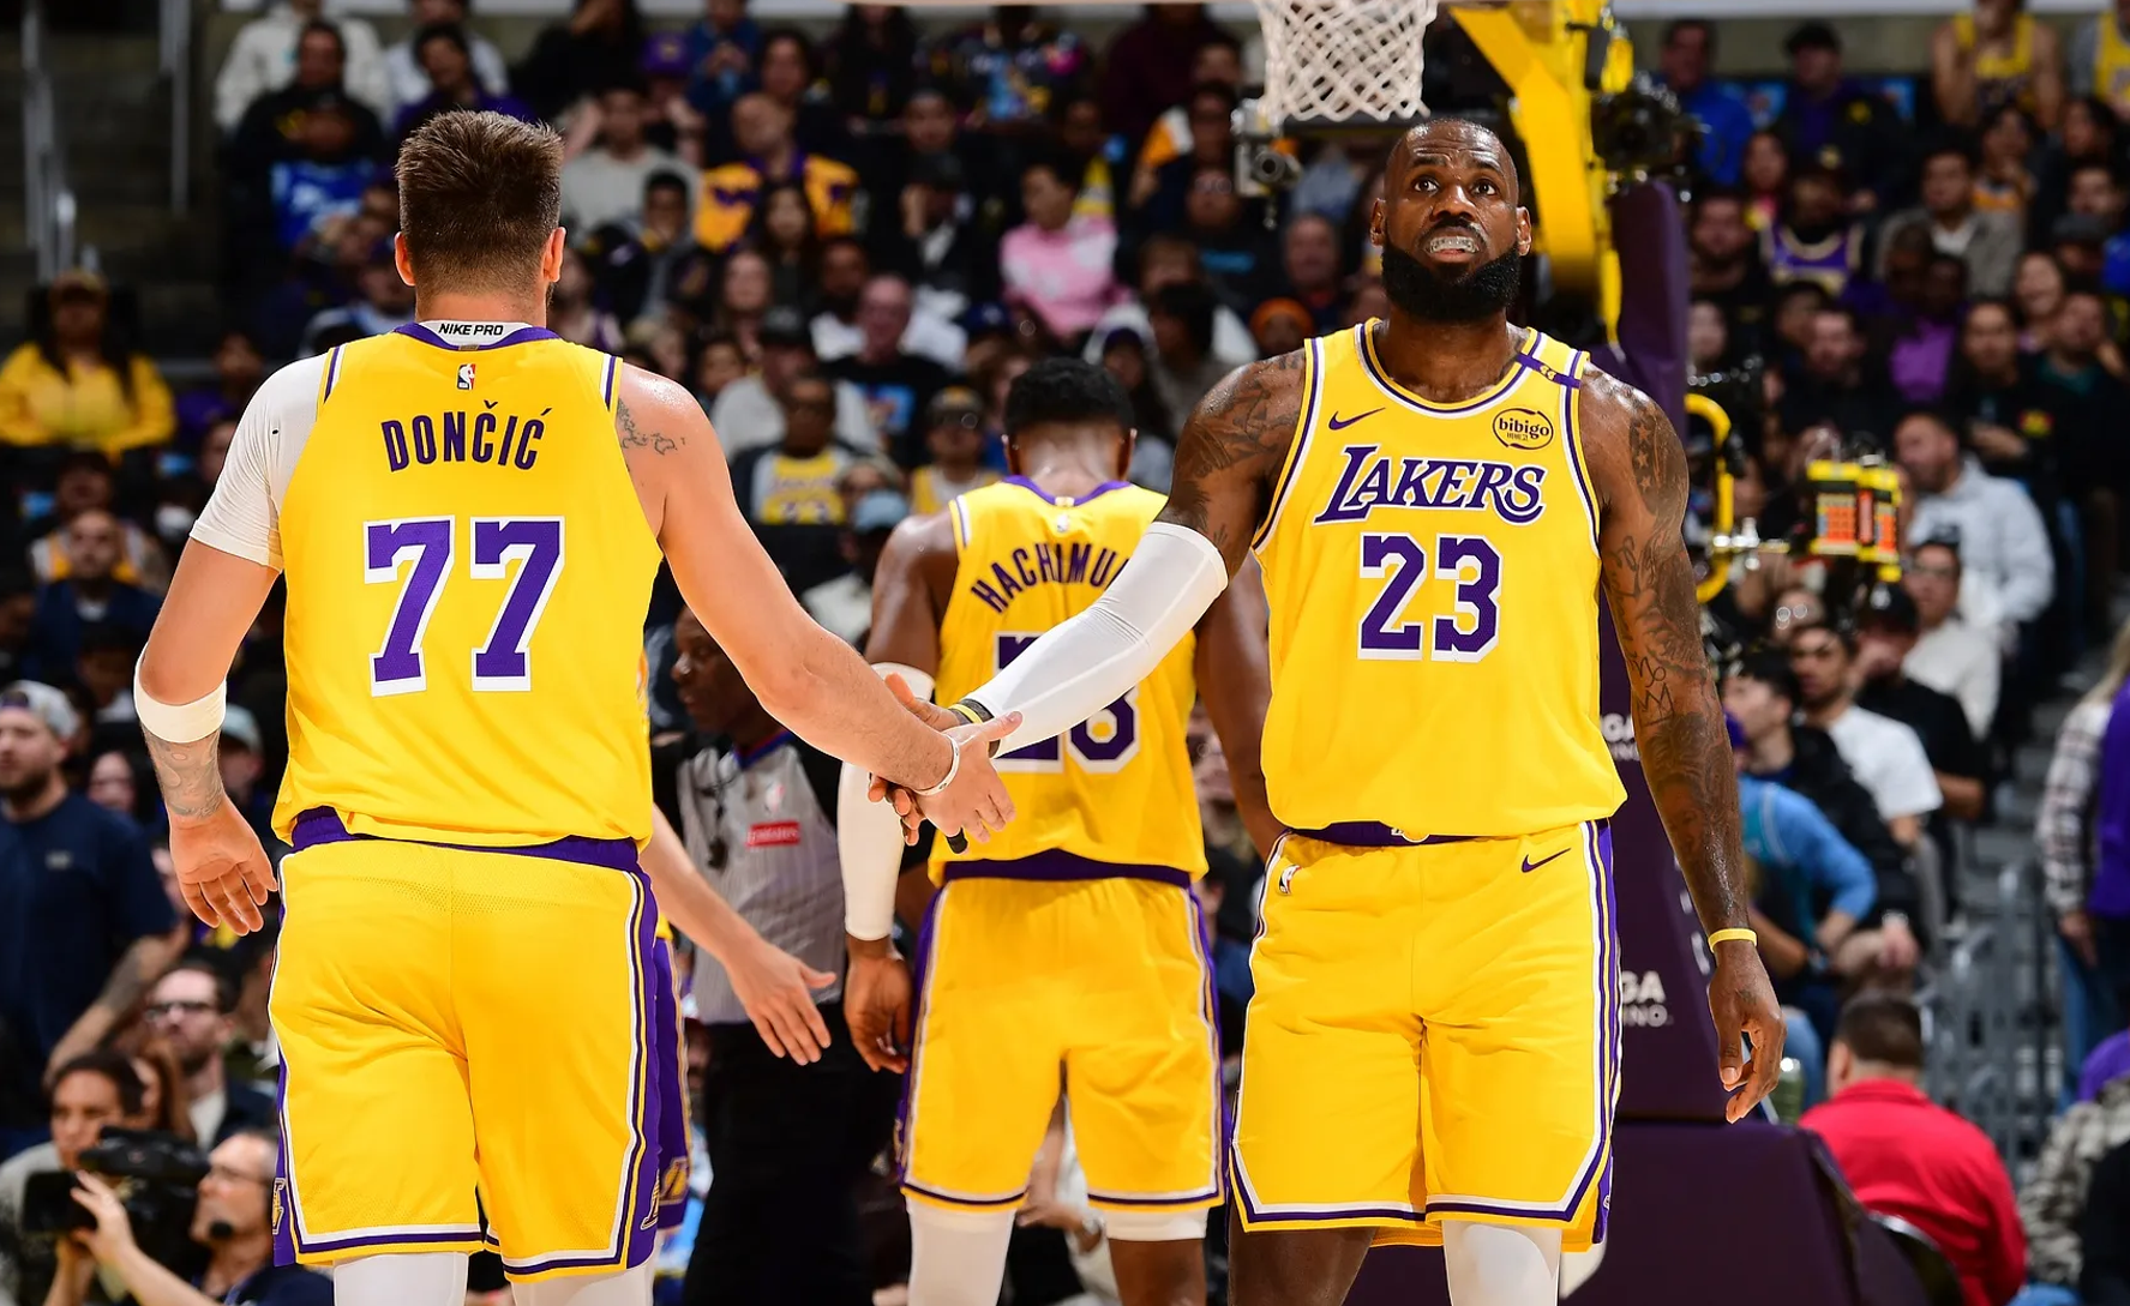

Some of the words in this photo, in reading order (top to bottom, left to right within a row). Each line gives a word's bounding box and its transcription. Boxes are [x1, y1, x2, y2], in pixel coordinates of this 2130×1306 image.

[439, 323, 472, 336] NIKE
[473, 324, 504, 336] PRO
[381, 399, 552, 472] DONČIĆ
[1499, 417, 1550, 440] bibigo
[1312, 444, 1547, 526] LAKERS
[363, 514, 566, 697] 77
[971, 542, 1129, 614] HACHIMU
[1357, 532, 1503, 662] 23
